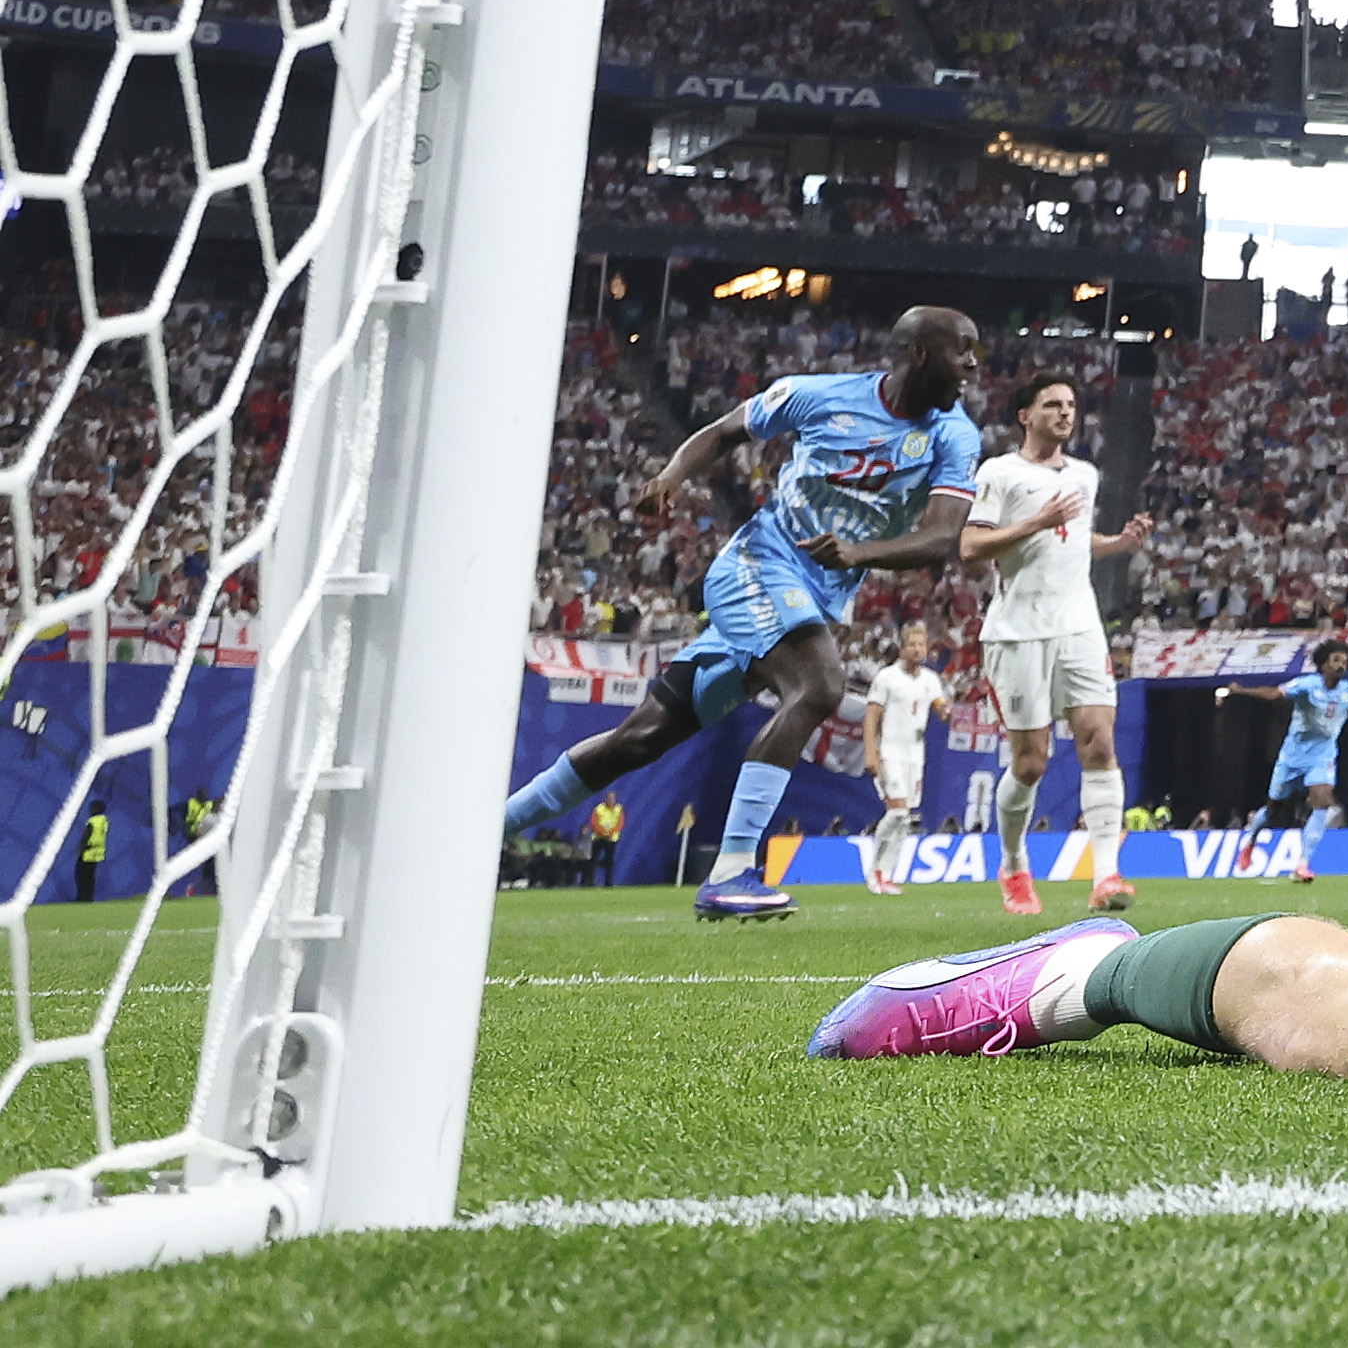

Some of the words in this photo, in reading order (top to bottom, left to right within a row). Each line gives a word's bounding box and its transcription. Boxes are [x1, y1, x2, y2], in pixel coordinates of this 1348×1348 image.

[52, 5, 113, 32] CUP
[677, 76, 881, 109] ATLANTA
[825, 449, 895, 492] 20
[1169, 829, 1303, 879] VISA
